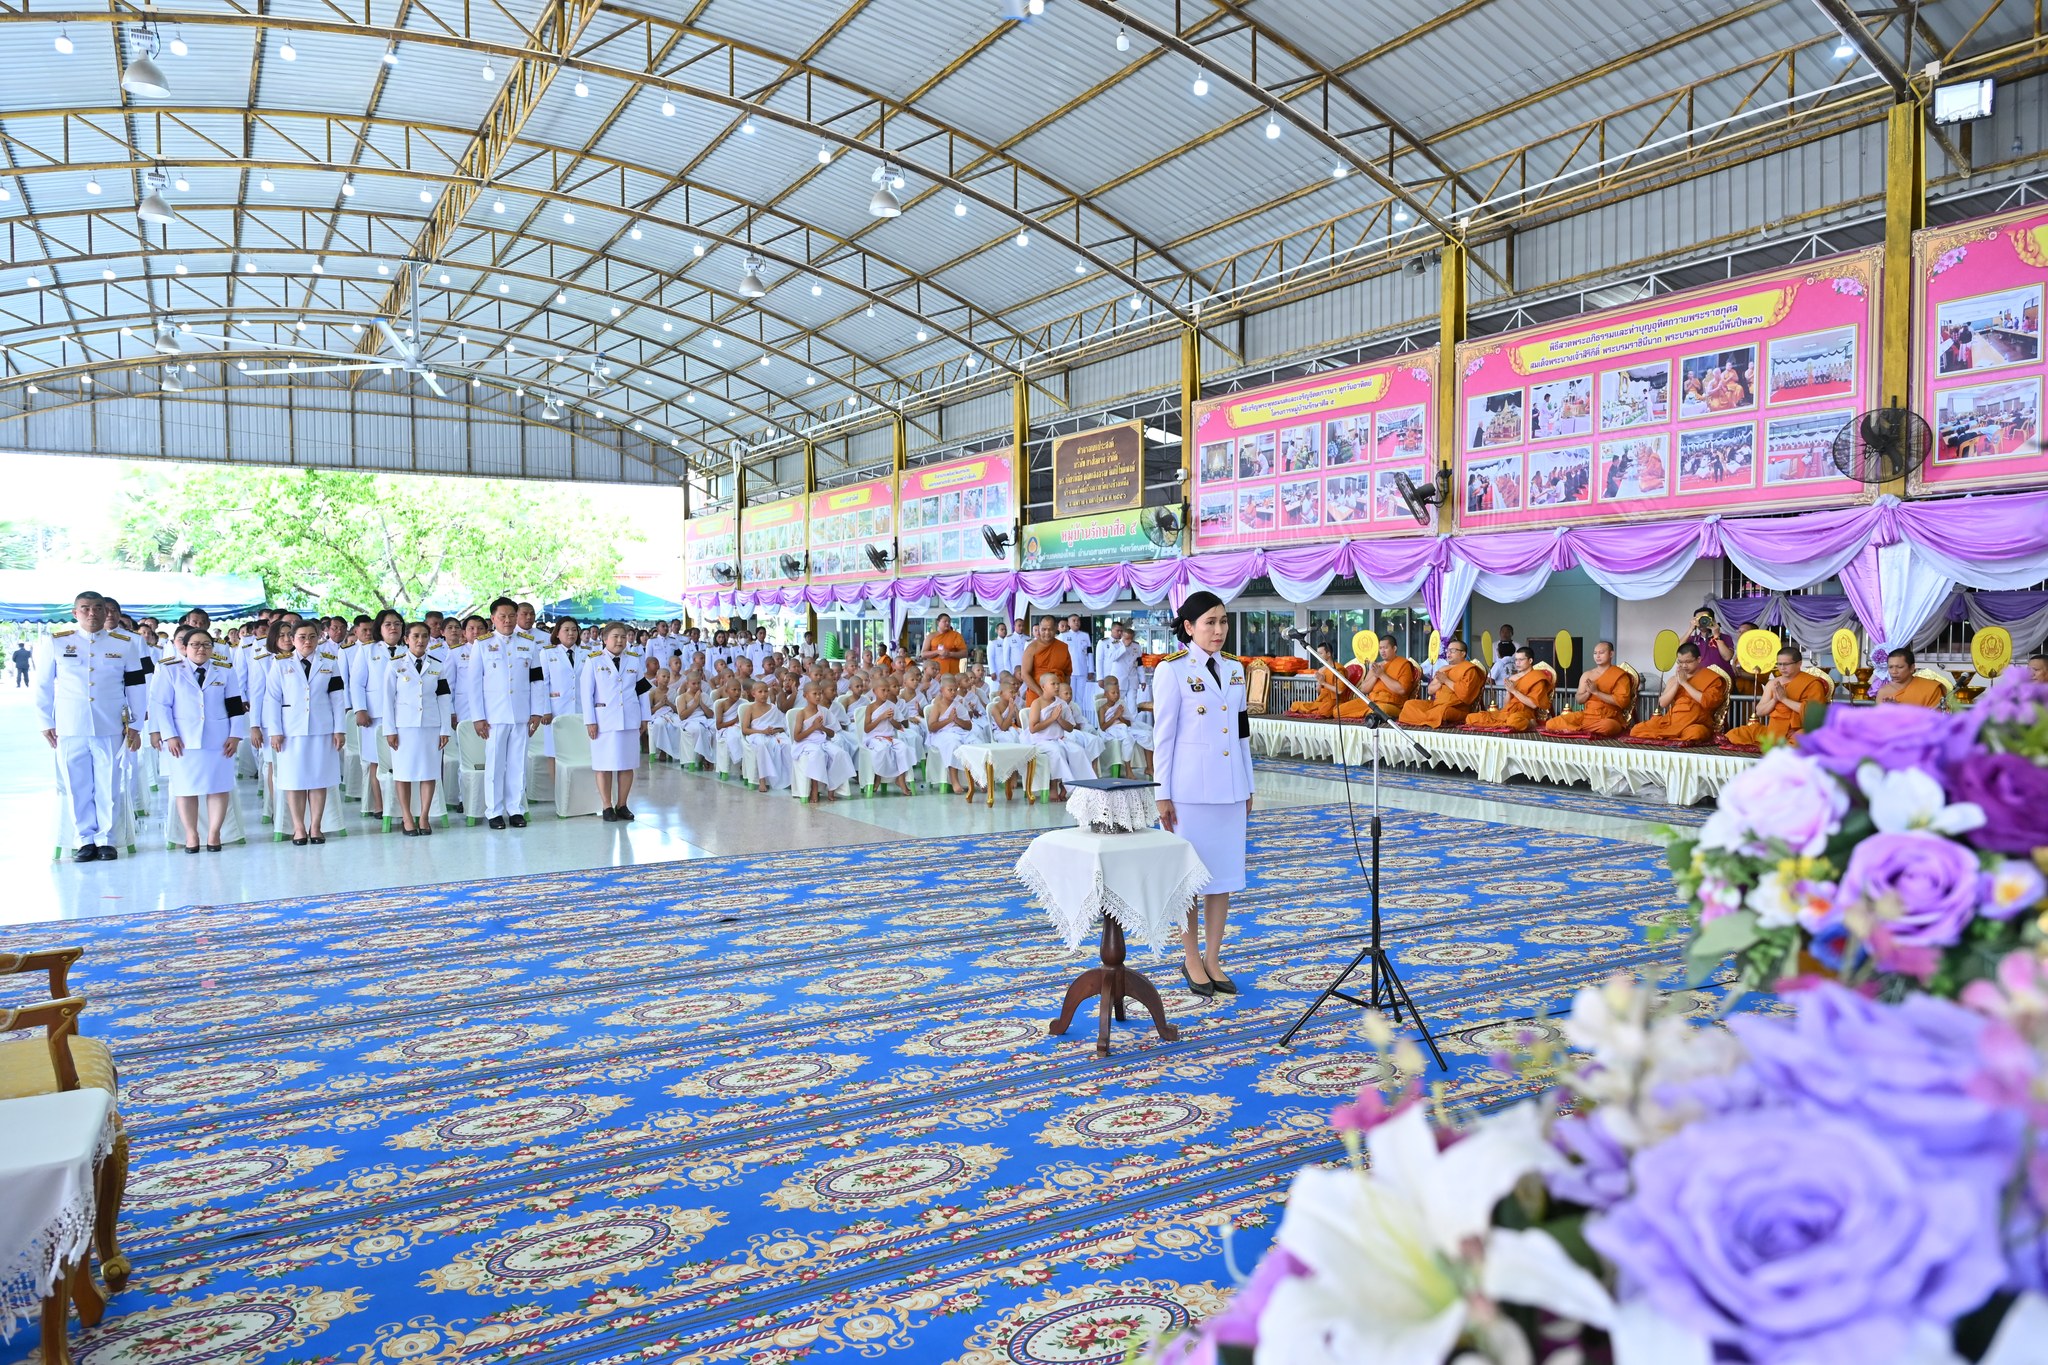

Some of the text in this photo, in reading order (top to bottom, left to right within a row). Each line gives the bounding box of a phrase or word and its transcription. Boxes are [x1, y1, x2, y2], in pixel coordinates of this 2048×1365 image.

[1061, 519, 1125, 546] หมู่บ้านรักษาศีล
